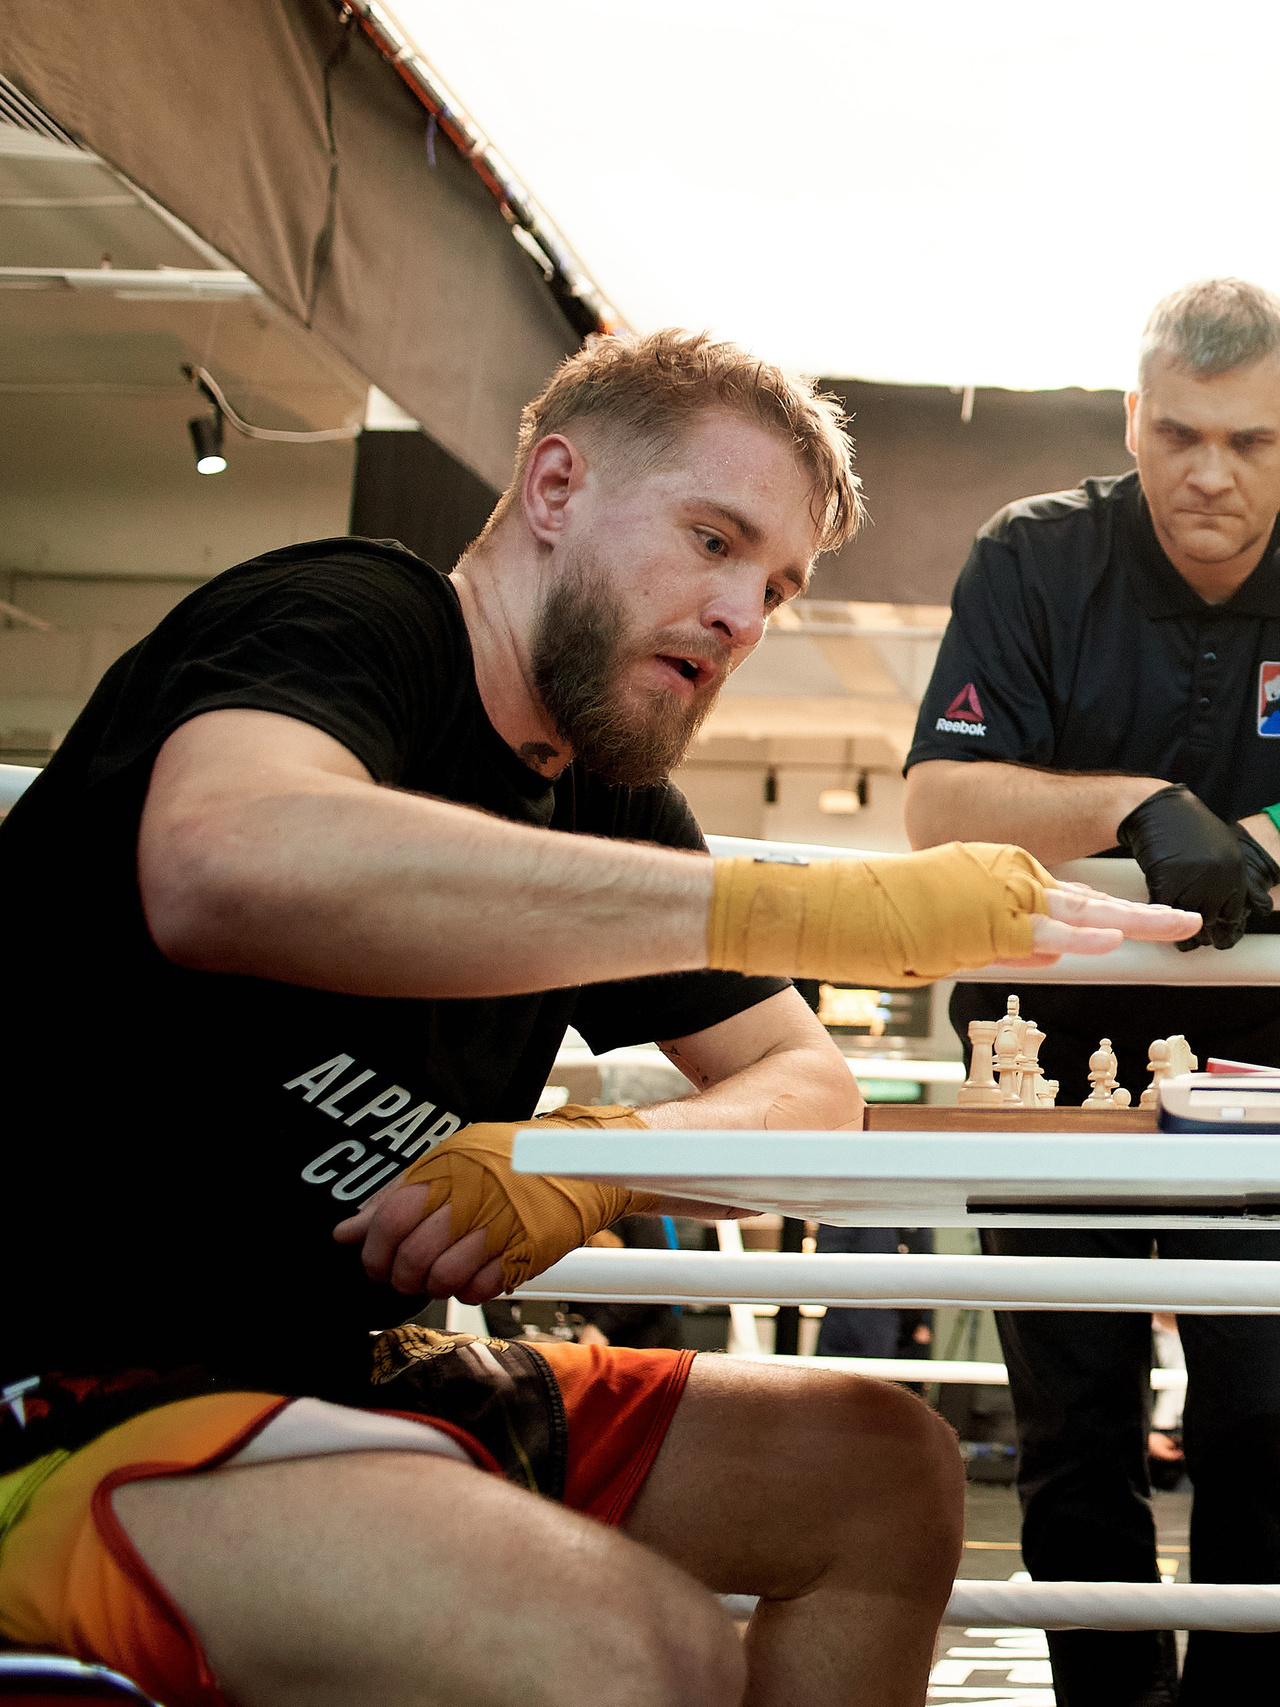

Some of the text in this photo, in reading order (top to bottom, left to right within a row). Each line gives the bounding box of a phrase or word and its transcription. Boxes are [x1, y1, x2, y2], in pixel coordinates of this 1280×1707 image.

[935, 717, 987, 736] Reebok
[283, 1053, 464, 1159] ALPAR
[301, 1139, 402, 1207] CU
